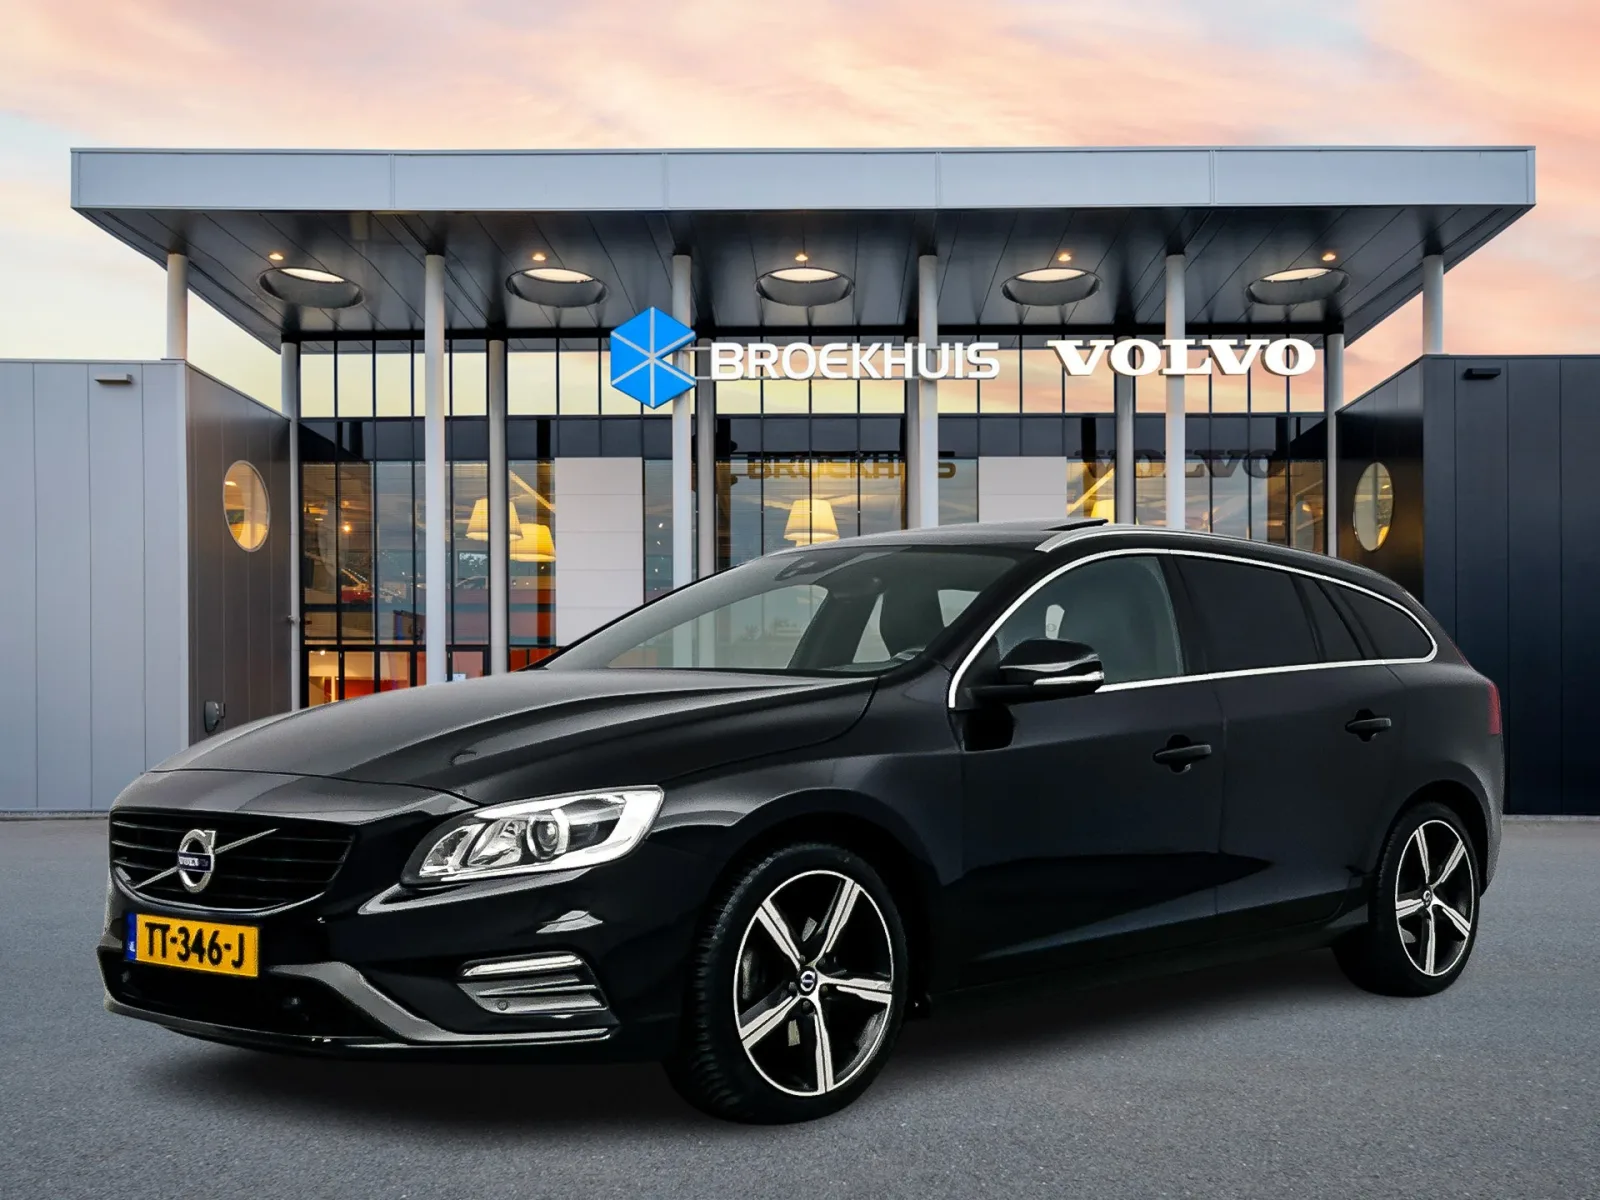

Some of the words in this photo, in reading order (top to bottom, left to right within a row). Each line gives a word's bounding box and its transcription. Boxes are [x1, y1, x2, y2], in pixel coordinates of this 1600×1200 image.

[711, 342, 1000, 380] BROEKHUIS
[1046, 338, 1316, 376] VOLVO
[144, 921, 245, 969] TT-346-J
